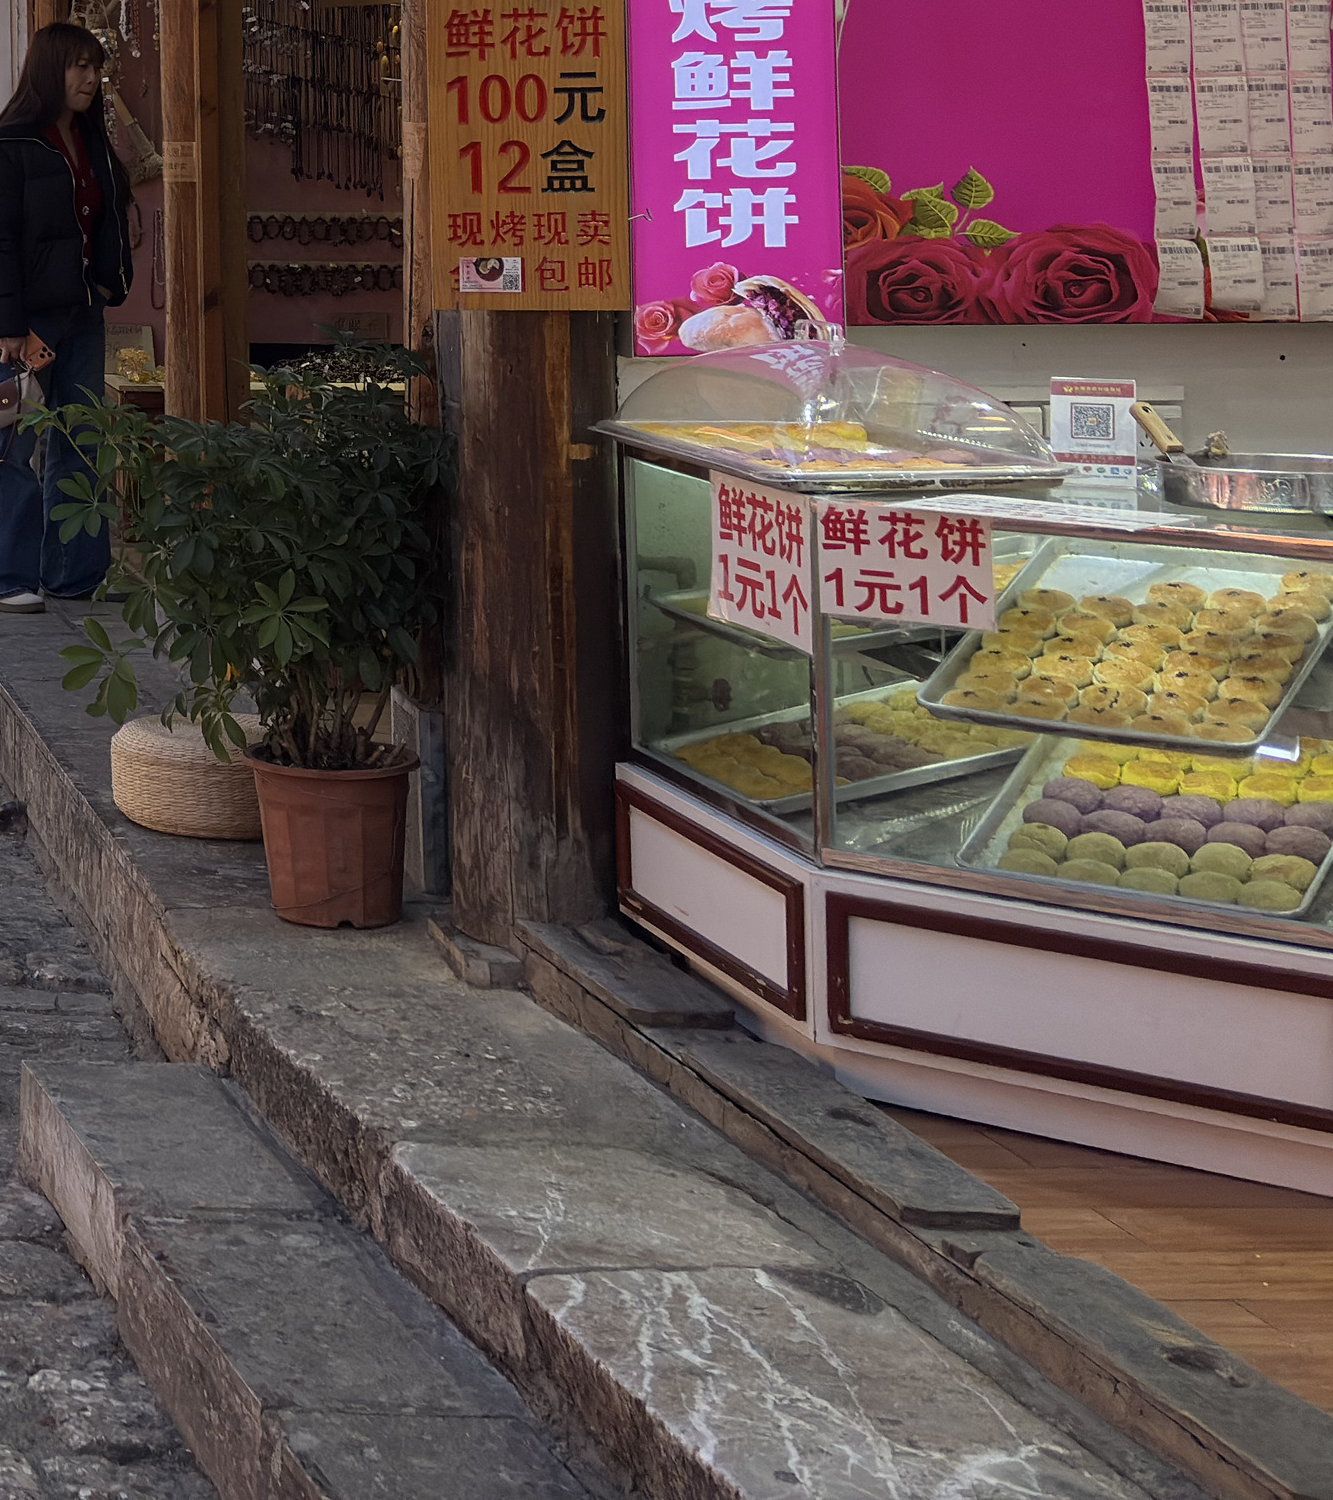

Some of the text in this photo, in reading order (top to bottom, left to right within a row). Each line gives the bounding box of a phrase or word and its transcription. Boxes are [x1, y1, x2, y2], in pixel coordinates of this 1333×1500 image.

[443, 5, 607, 61] 鲜花饼
[445, 71, 606, 126] 100元
[458, 139, 596, 195] 12盒
[447, 209, 611, 248] 现烤现卖
[718, 483, 804, 567] 鲜花饼
[820, 506, 986, 566] 鲜花饼
[718, 553, 808, 636] 1元1个
[824, 567, 988, 623] 1元1个
